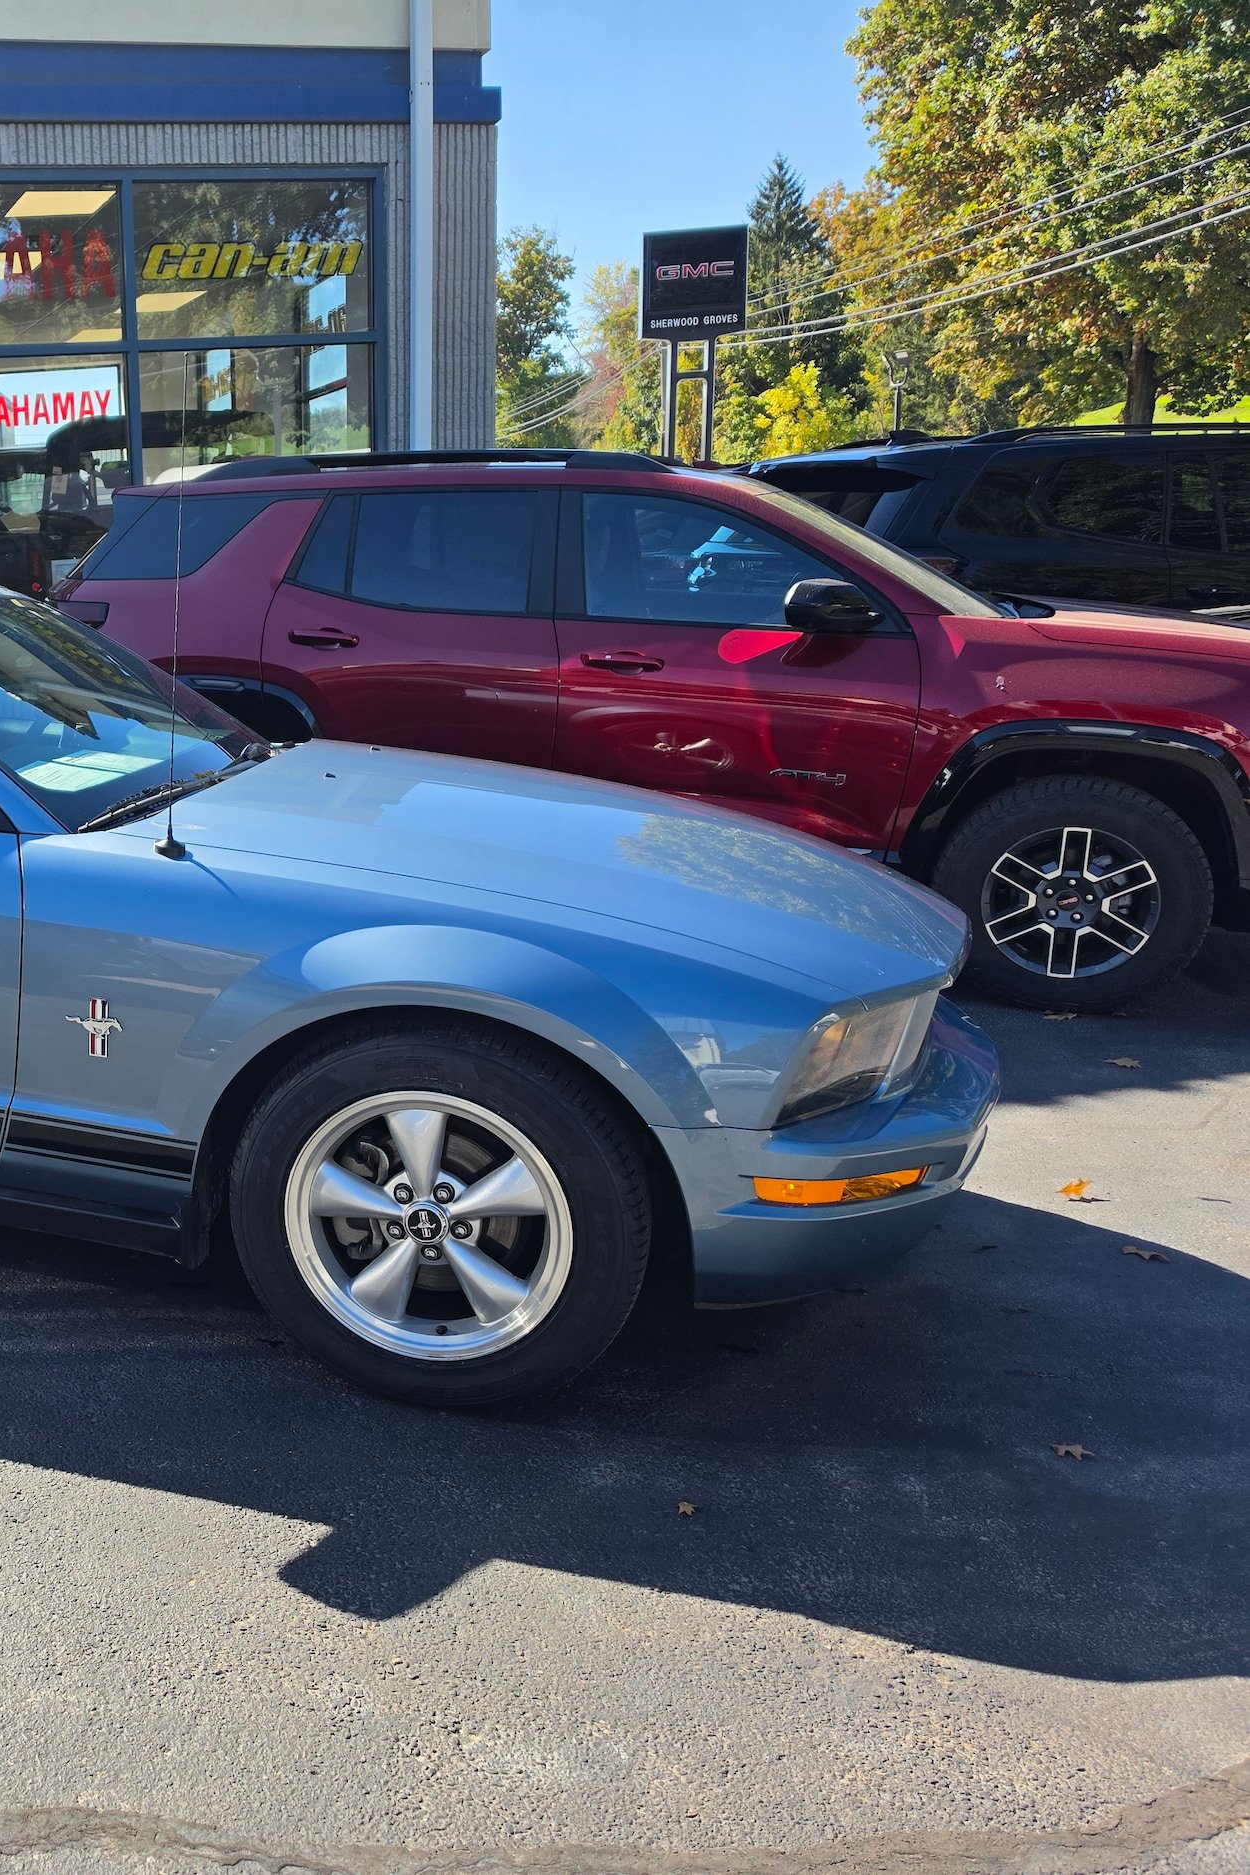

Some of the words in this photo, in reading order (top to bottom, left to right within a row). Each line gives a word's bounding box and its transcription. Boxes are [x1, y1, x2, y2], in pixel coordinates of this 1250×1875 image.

[142, 239, 364, 280] can-am
[656, 260, 735, 281] GMC
[650, 316, 699, 329] SHERWOOD
[703, 313, 738, 326] GROVES
